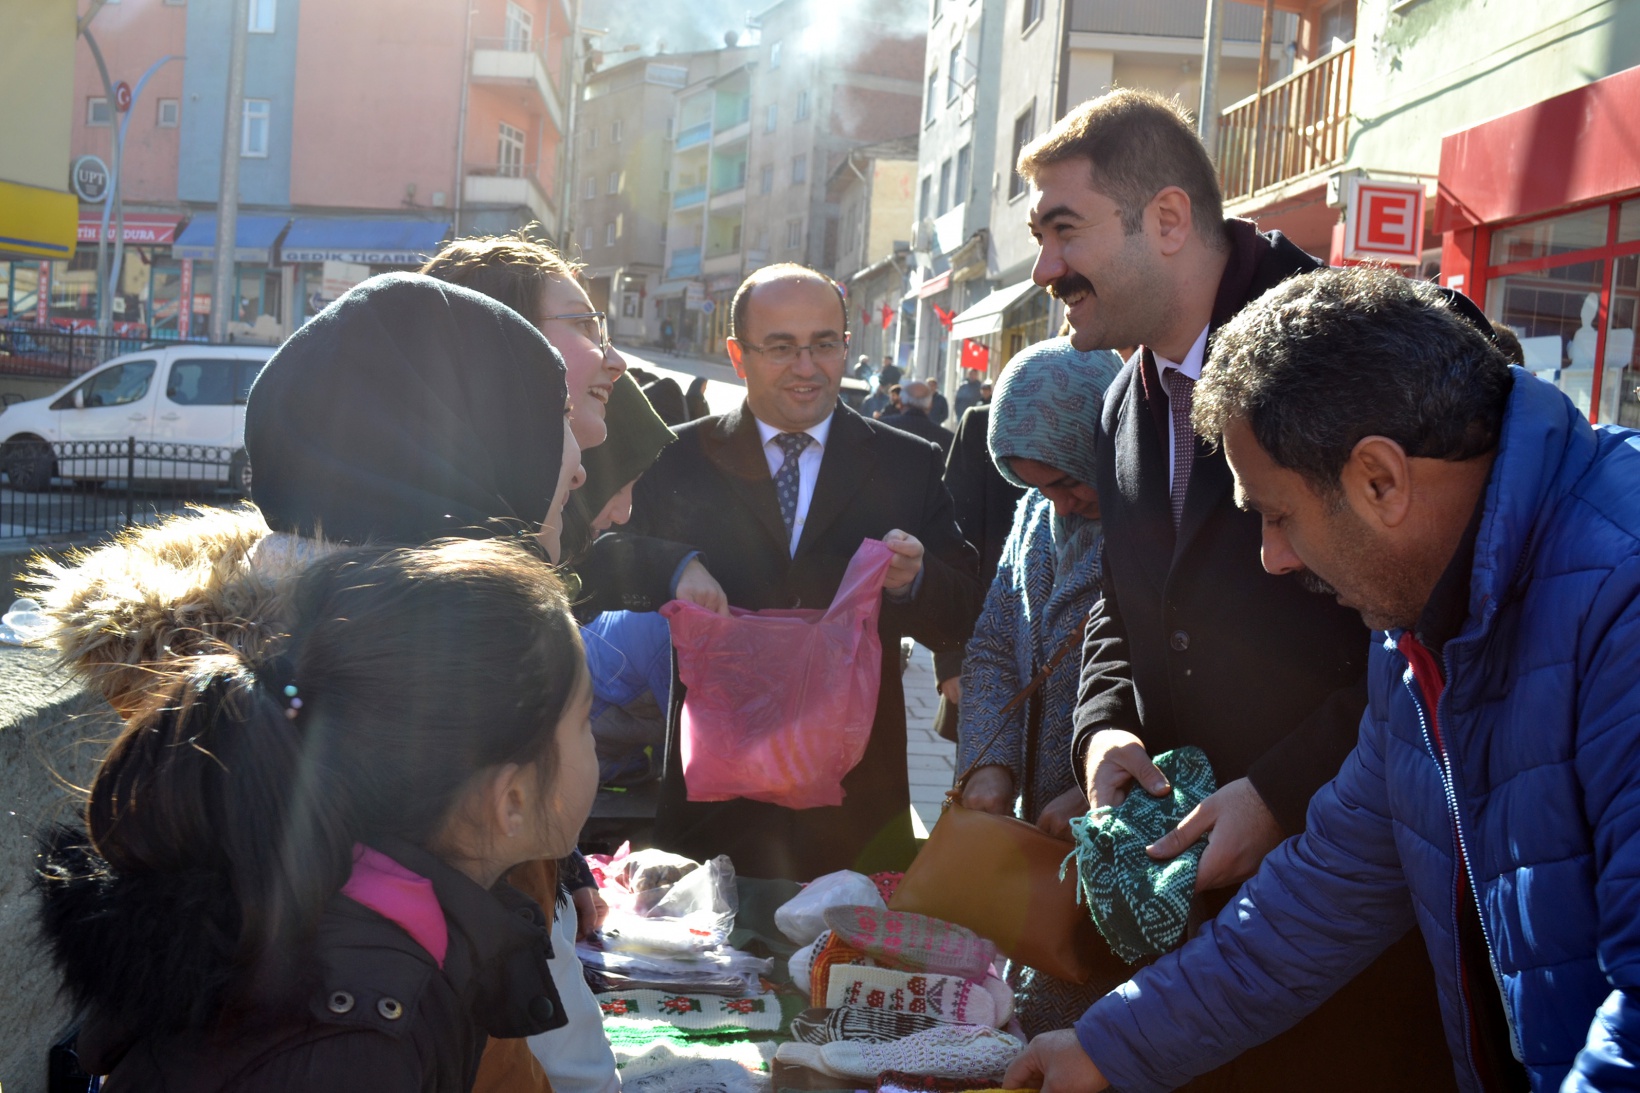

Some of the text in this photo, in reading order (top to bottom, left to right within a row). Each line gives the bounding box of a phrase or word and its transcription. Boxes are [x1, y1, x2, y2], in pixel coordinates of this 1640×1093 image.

[78, 169, 105, 185] UPT
[1367, 196, 1406, 245] E
[99, 228, 155, 240] UDURA
[286, 251, 343, 262] GEDİK
